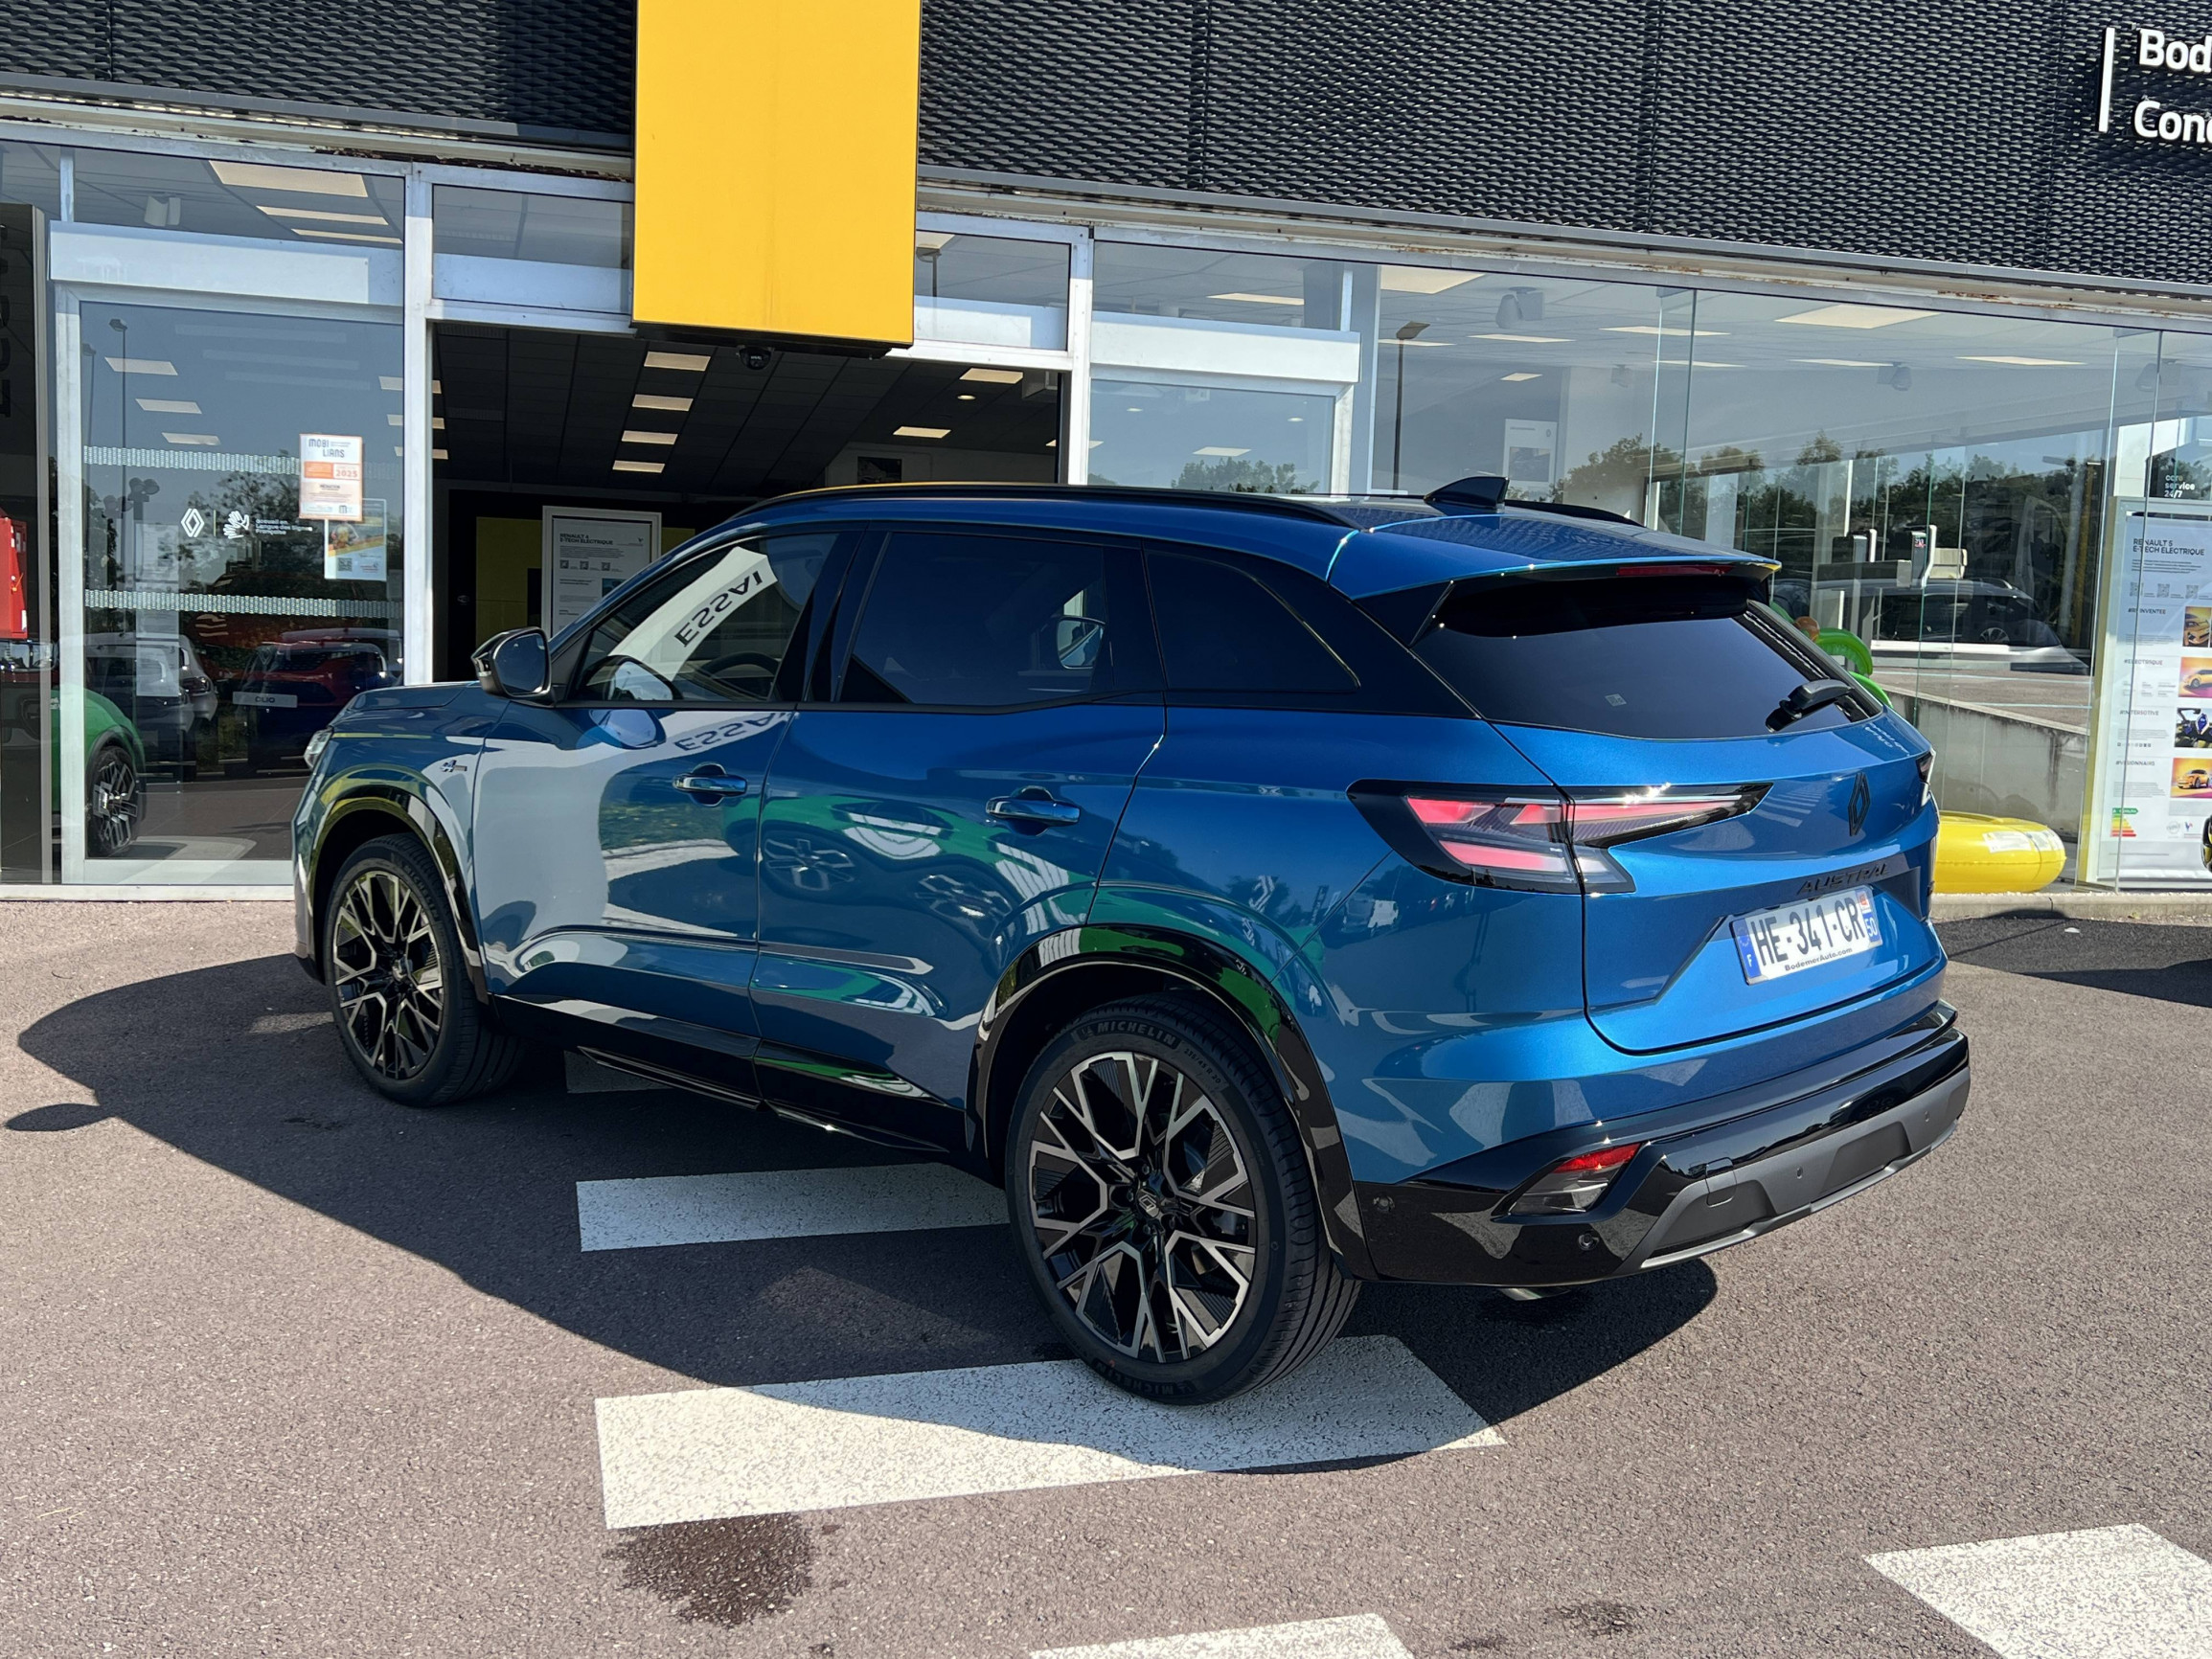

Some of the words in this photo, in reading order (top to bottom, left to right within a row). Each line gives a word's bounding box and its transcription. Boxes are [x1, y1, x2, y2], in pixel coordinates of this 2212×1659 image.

[2139, 28, 2212, 73] Bod
[335, 469, 358, 478] 2025
[2163, 489, 2183, 499] 24/7
[1796, 863, 1888, 895] AUSTRAL
[1866, 917, 1879, 937] 50
[1746, 954, 1753, 967] F
[1784, 946, 1853, 971] BodemerAuto.com
[1097, 1020, 1176, 1046] MICHELIN
